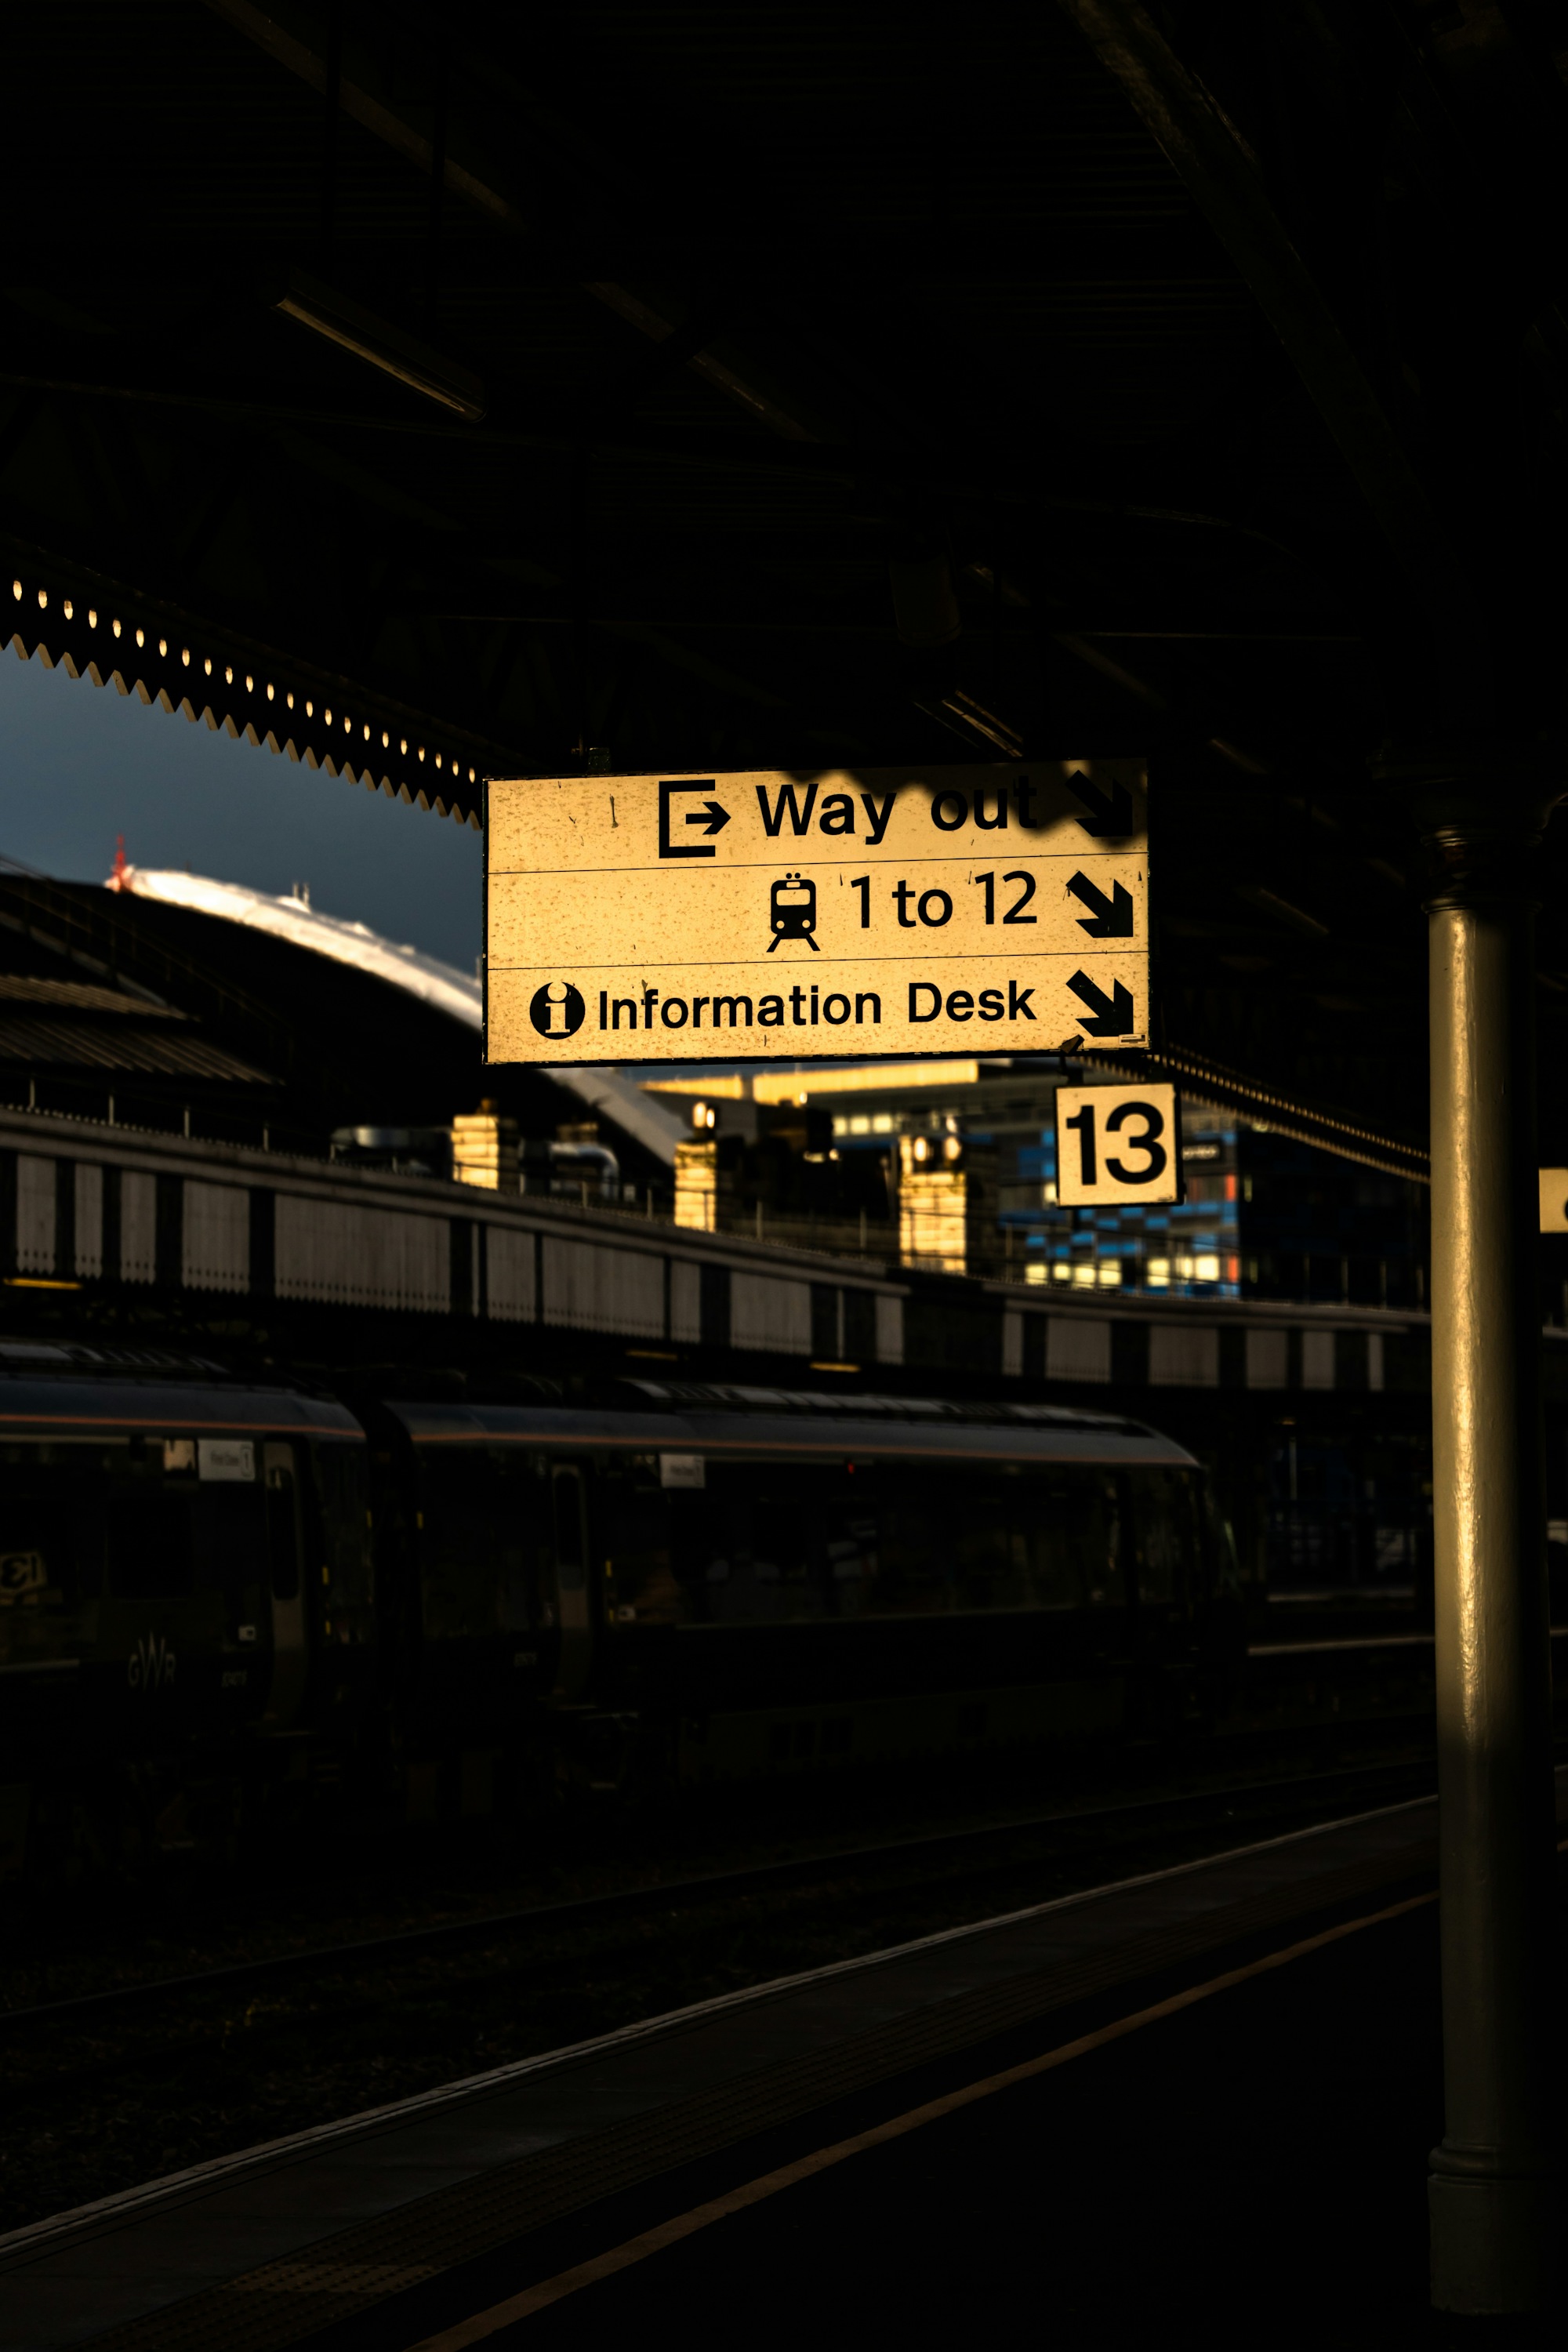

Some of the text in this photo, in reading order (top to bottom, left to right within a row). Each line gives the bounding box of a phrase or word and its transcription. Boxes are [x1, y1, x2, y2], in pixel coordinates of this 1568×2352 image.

[756, 775, 1037, 845] Way out
[851, 870, 1037, 928] 1 to 12
[599, 980, 1037, 1030] Information Desk
[1066, 1102, 1167, 1186] 13
[127, 1629, 176, 1693] GWR
